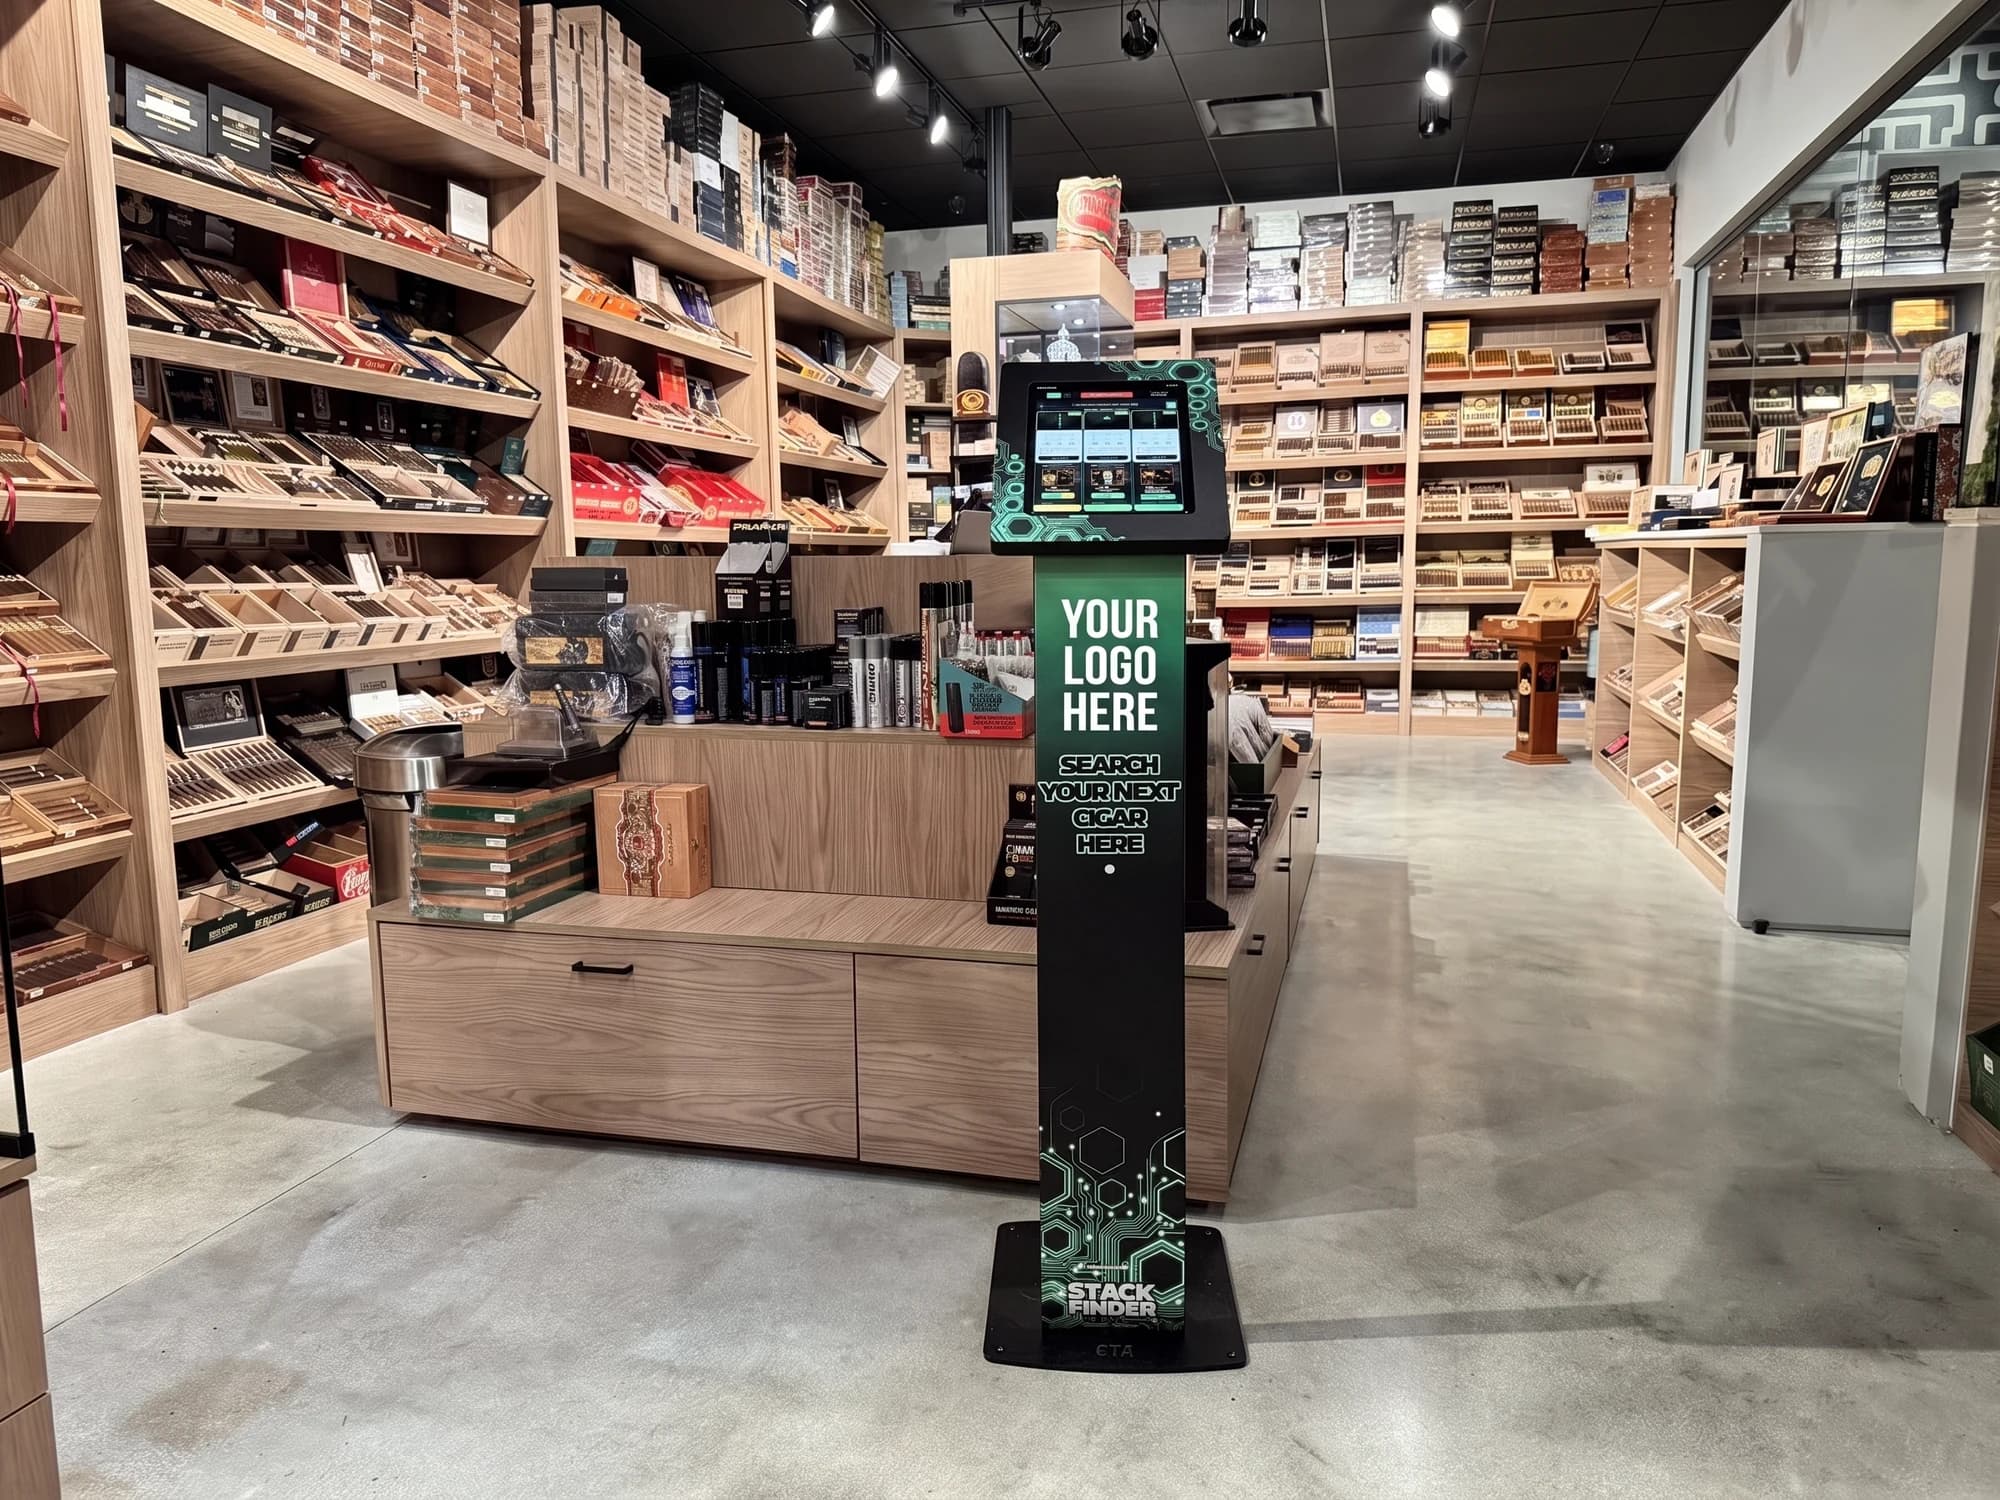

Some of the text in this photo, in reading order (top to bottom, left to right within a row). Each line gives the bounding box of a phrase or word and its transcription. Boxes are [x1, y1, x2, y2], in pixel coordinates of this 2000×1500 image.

[1061, 598, 1159, 639] YOUR
[1064, 645, 1157, 685] LOGO
[1063, 692, 1158, 732] HERE
[1059, 754, 1161, 776] SEARCH
[1037, 781, 1182, 803] YOUR NEXT
[1072, 807, 1148, 828] CIGAR
[1076, 833, 1145, 854] HERE
[1068, 1282, 1155, 1300] STACK
[1069, 1301, 1156, 1317] FINDER
